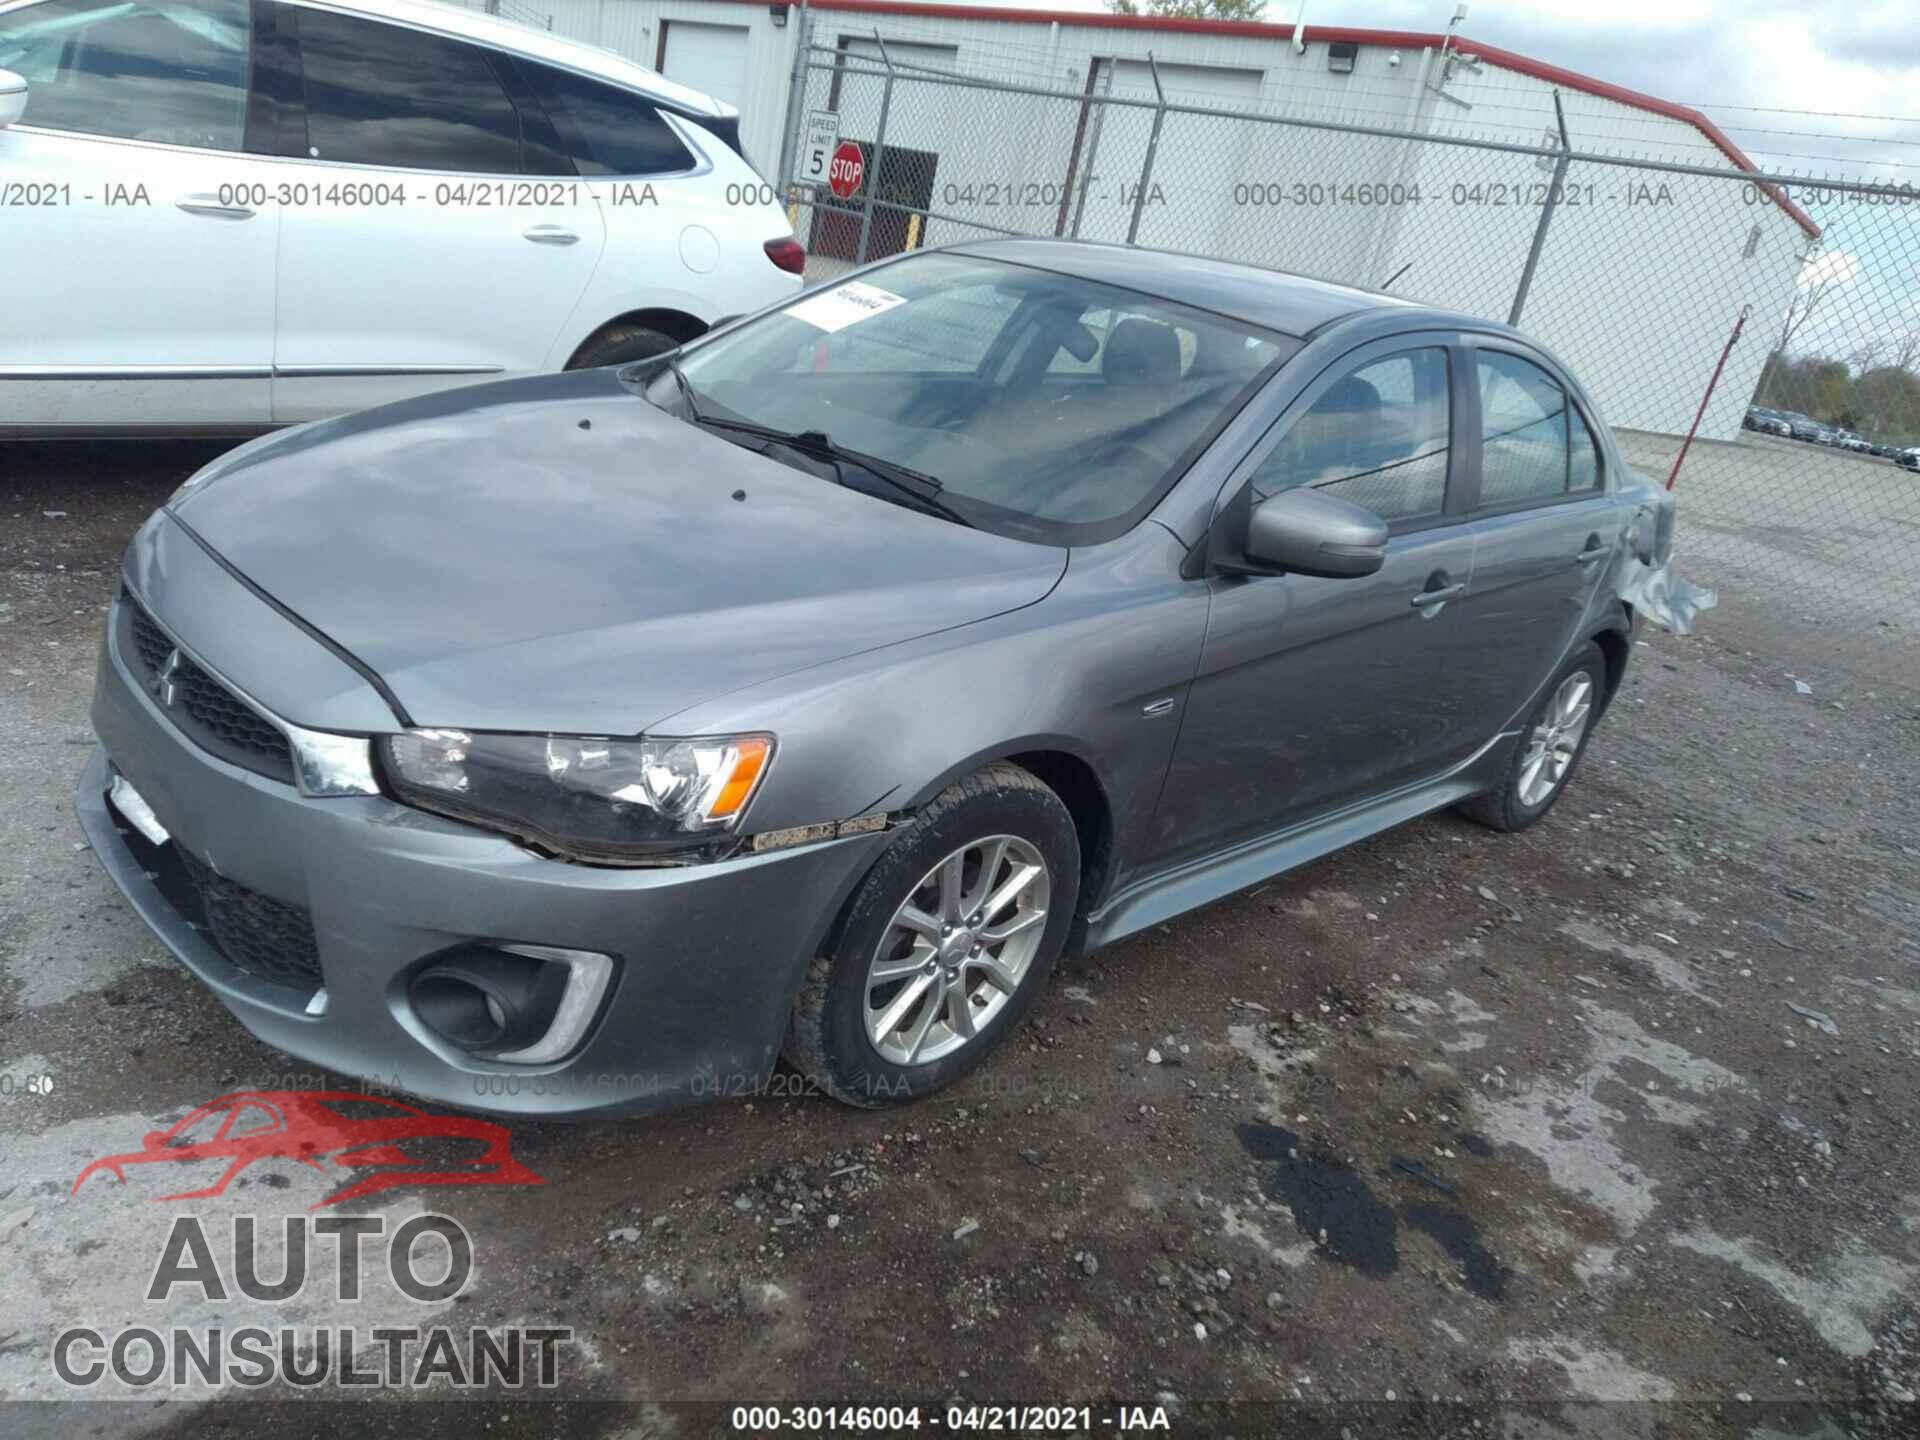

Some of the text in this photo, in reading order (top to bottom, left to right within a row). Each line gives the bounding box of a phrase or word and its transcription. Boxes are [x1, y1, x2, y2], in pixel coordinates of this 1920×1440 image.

[810, 118, 836, 131] SPEED
[810, 134, 832, 145] LIMIT
[810, 149, 824, 174] 5
[831, 157, 860, 182] STOP
